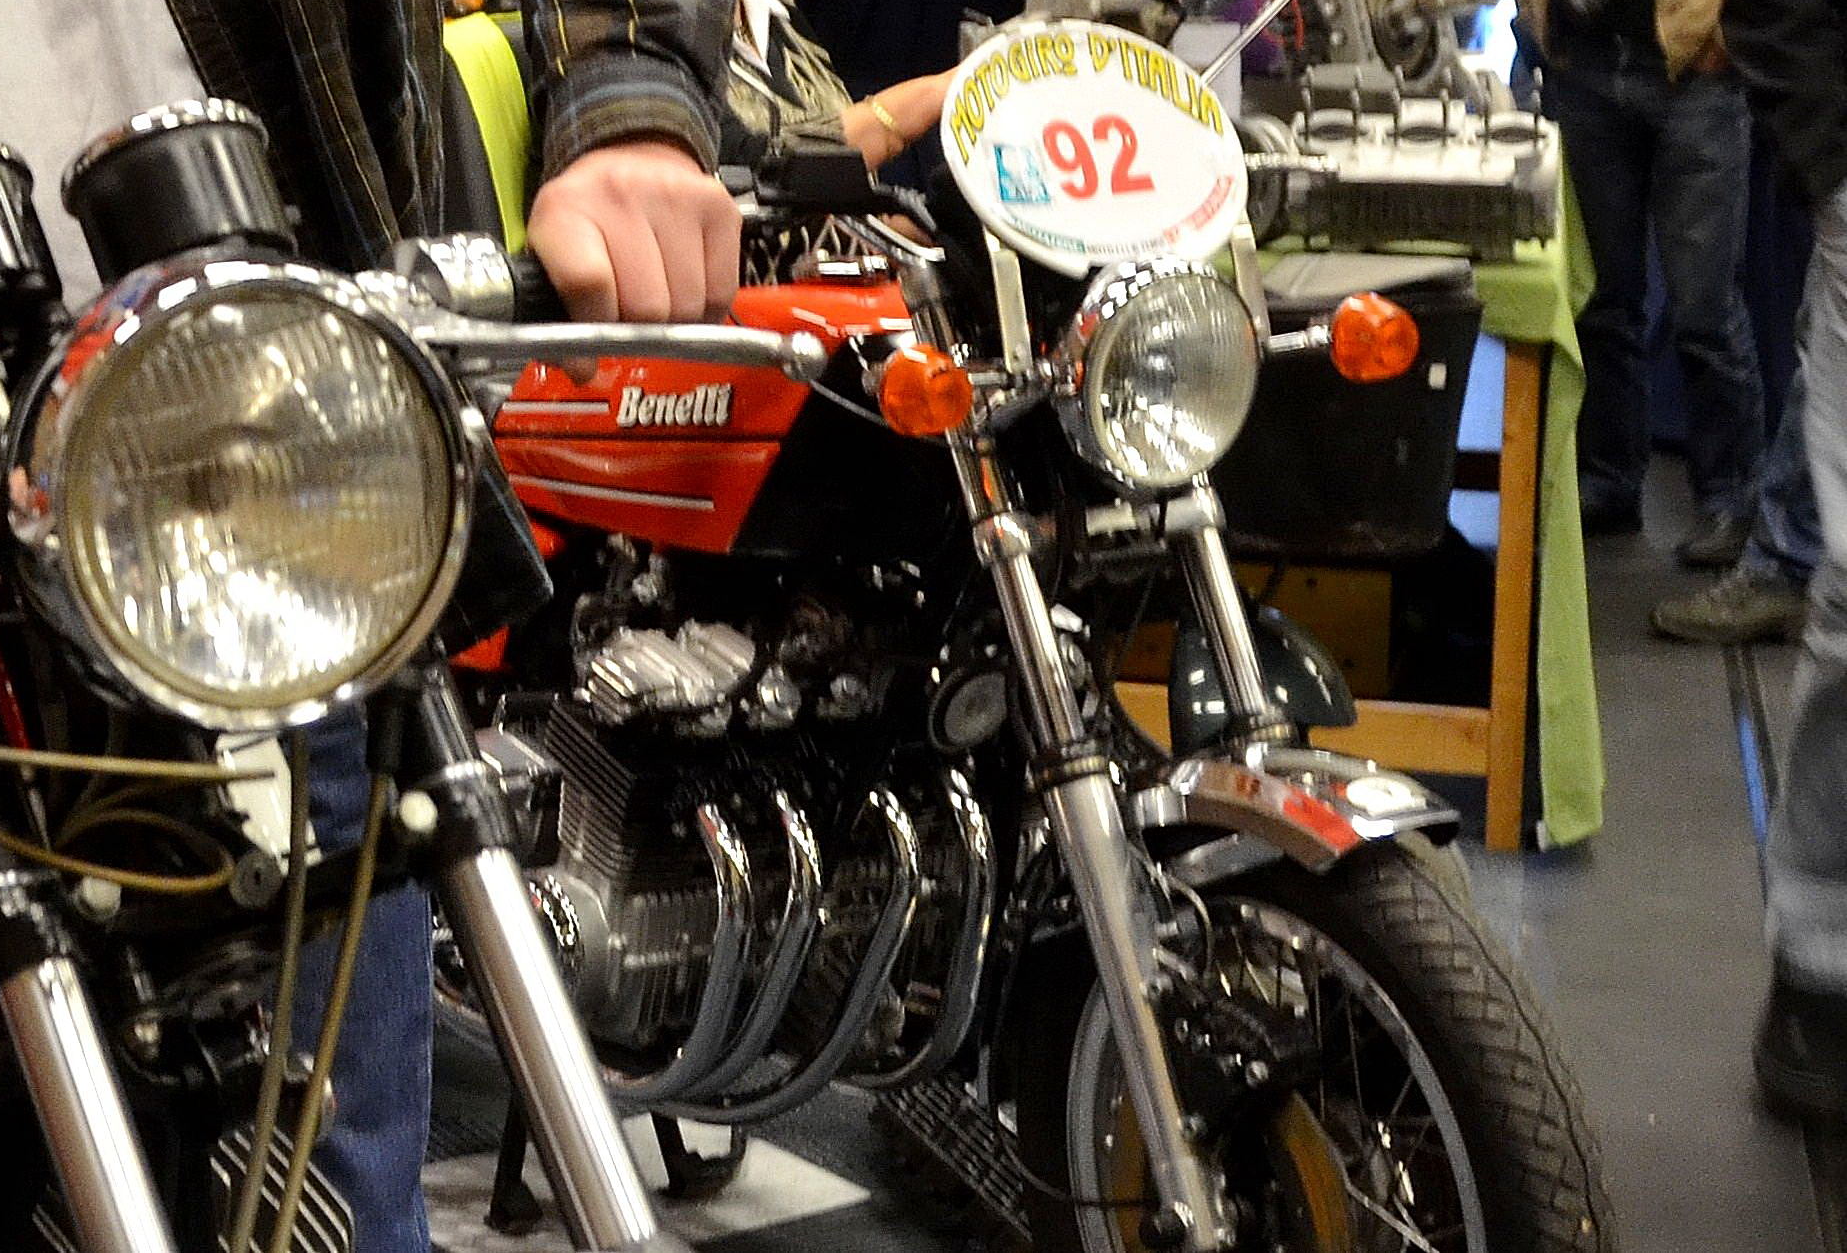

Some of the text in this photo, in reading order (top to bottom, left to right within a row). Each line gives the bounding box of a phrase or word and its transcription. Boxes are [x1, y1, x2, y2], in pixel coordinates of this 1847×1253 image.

[950, 33, 1078, 166] MOTOGIRO
[1042, 114, 1155, 200] 92
[616, 383, 733, 427] Benelli
